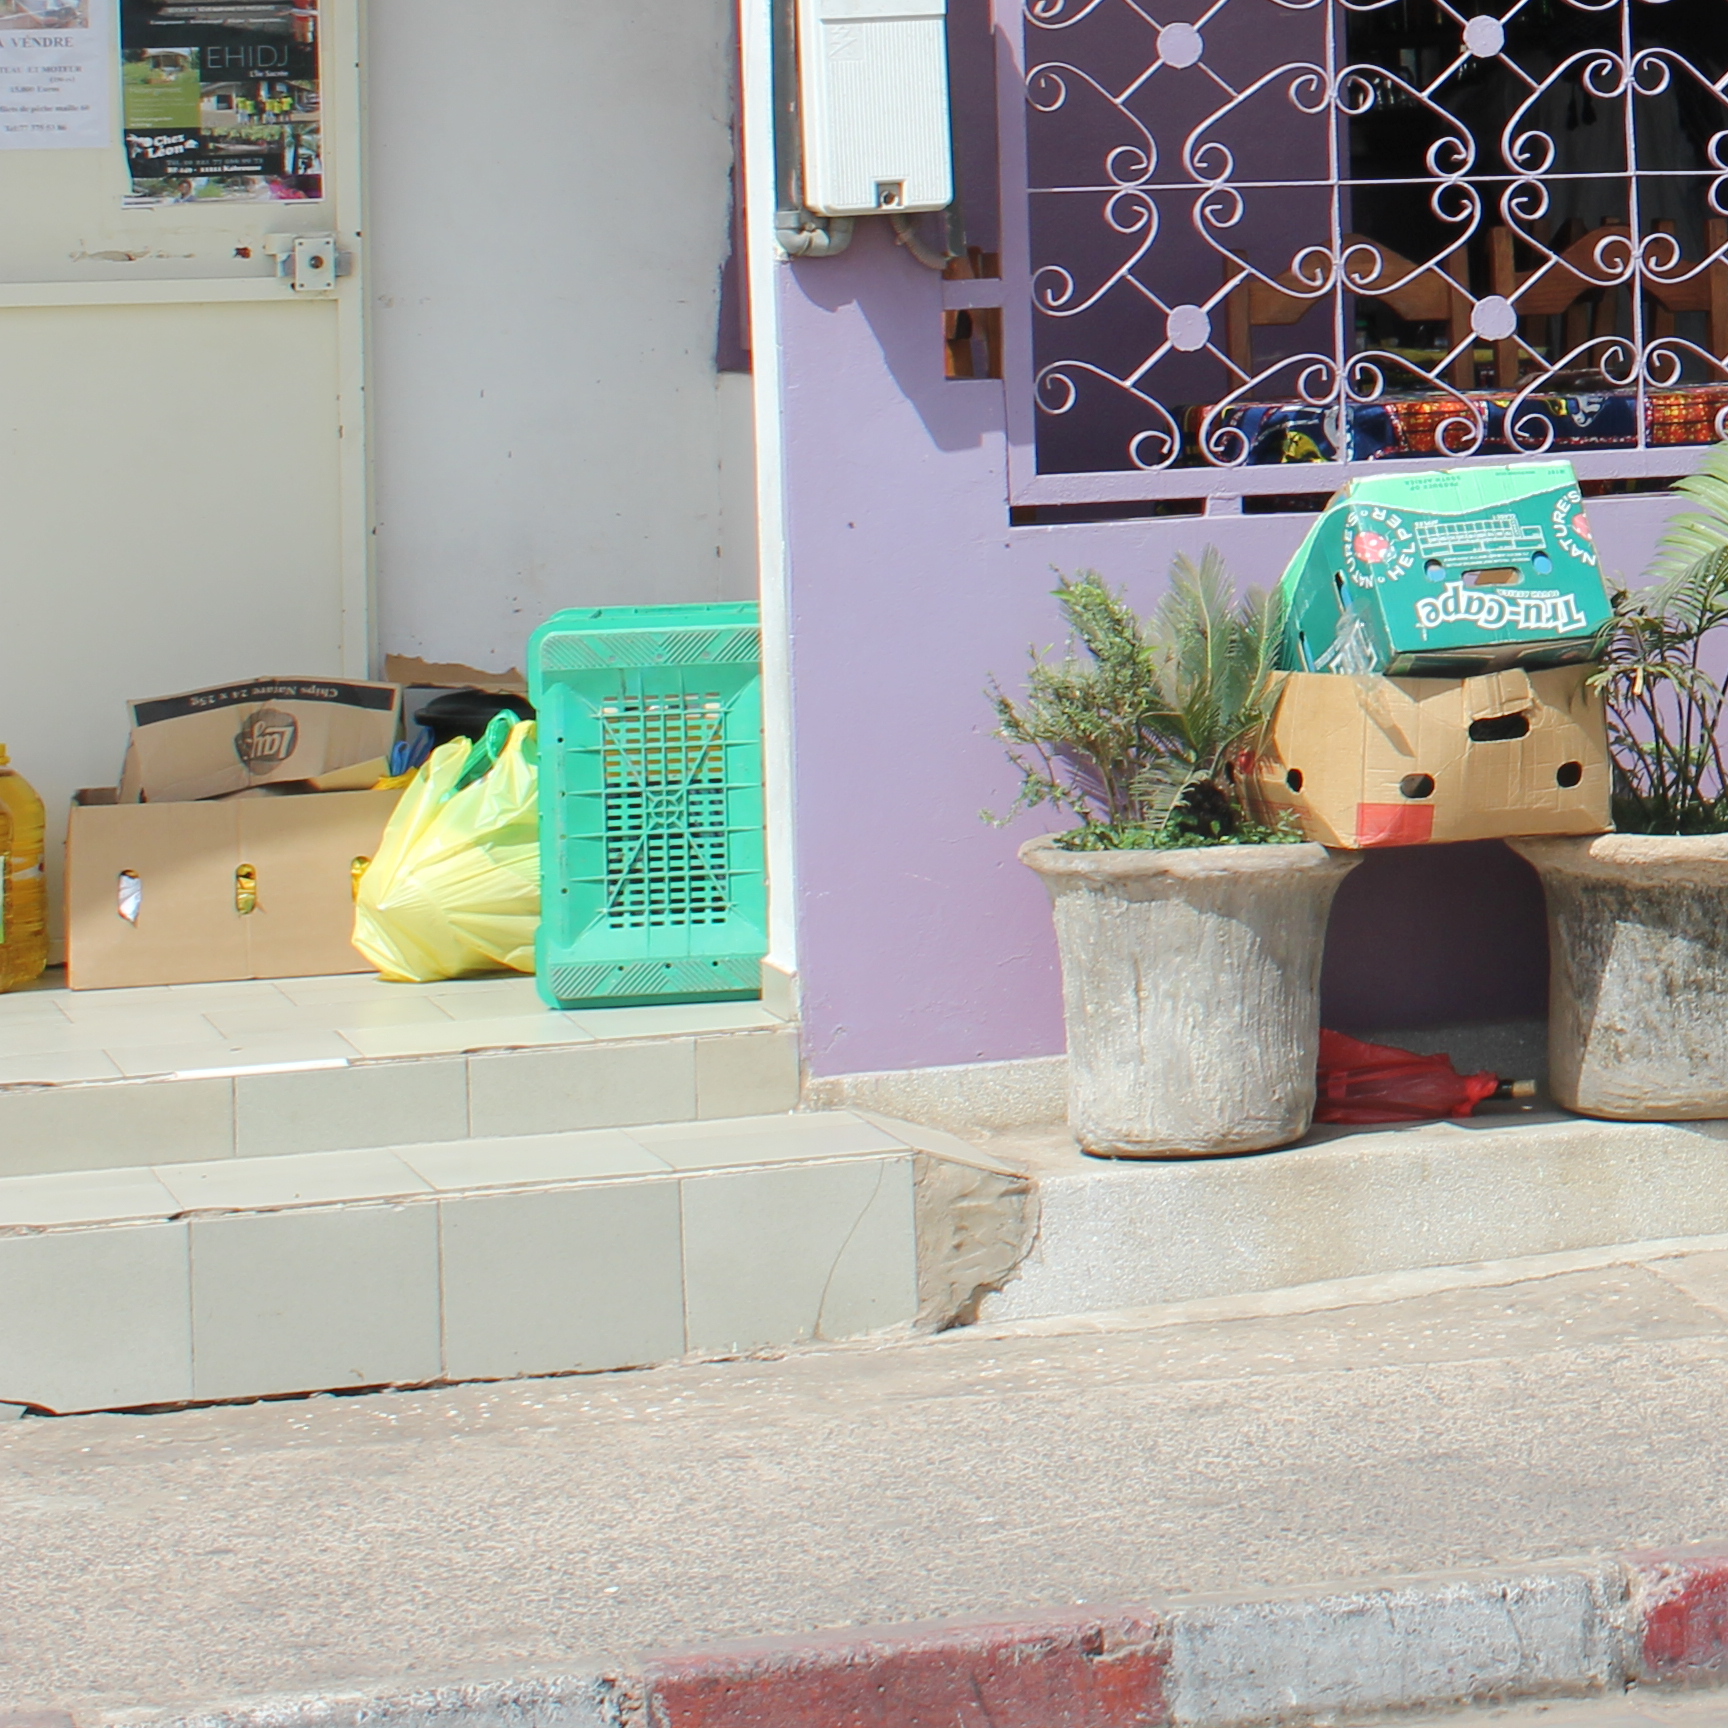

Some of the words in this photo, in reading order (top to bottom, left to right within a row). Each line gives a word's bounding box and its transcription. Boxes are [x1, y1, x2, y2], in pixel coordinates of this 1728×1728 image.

[206, 45, 288, 69] EHIDJ
[154, 134, 185, 145] Chez
[1552, 490, 1597, 567] NATURE'S
[1371, 506, 1418, 582] HELPER
[300, 685, 339, 698] Chips
